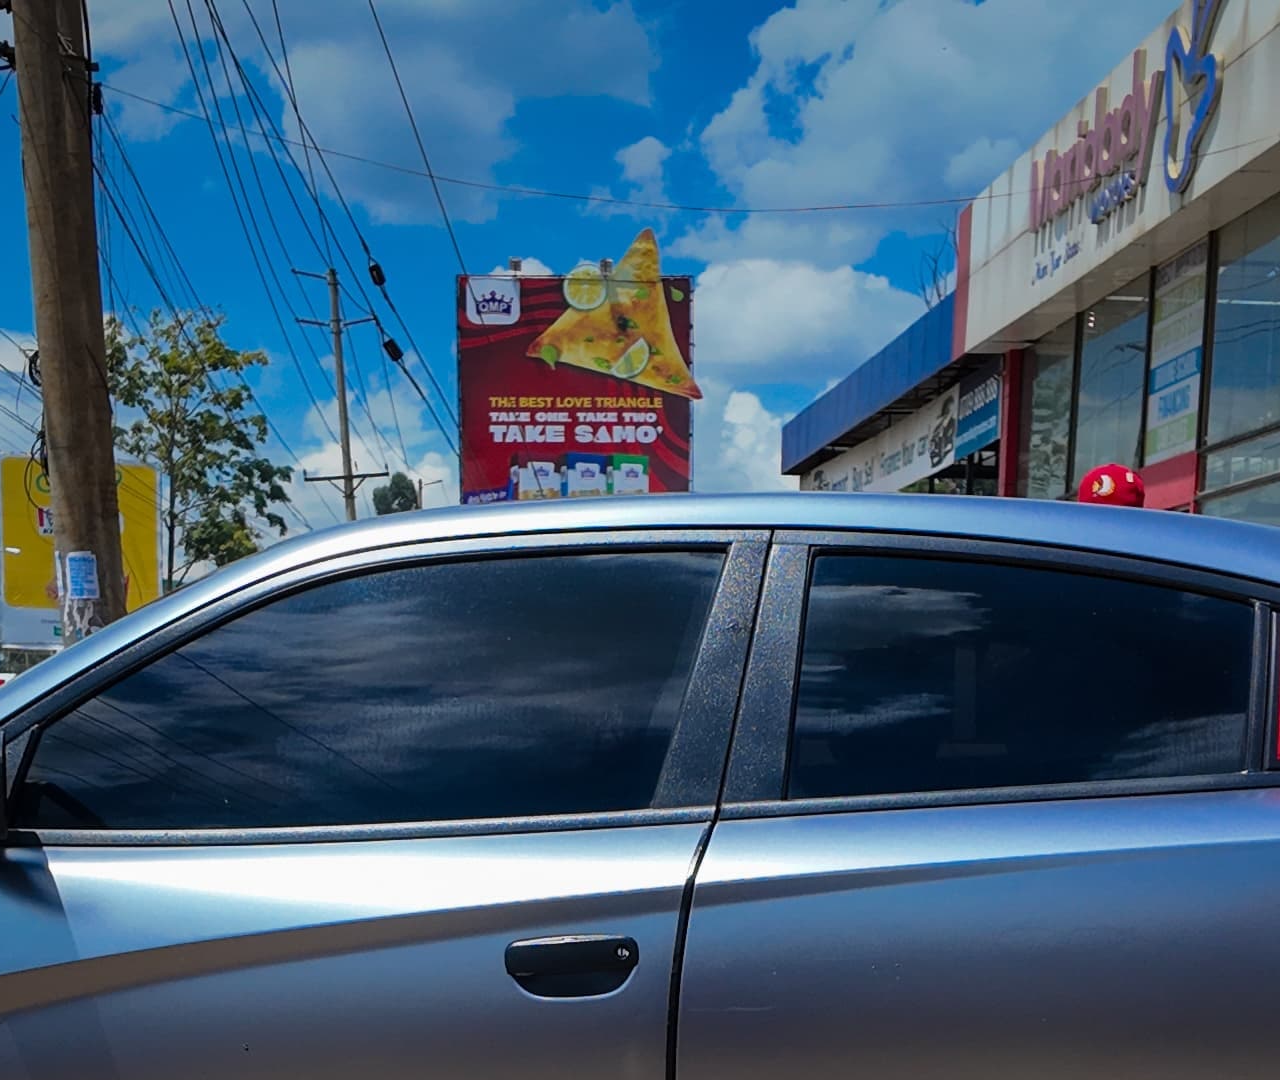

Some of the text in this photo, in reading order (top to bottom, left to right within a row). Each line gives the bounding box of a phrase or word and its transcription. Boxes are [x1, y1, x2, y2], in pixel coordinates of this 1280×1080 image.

[488, 396, 663, 409] THE BEST LOVE TRIANGLE
[488, 411, 531, 423] TAKE
[576, 411, 618, 423] TAKE
[622, 411, 658, 423] TWO
[488, 425, 566, 443] TAKE
